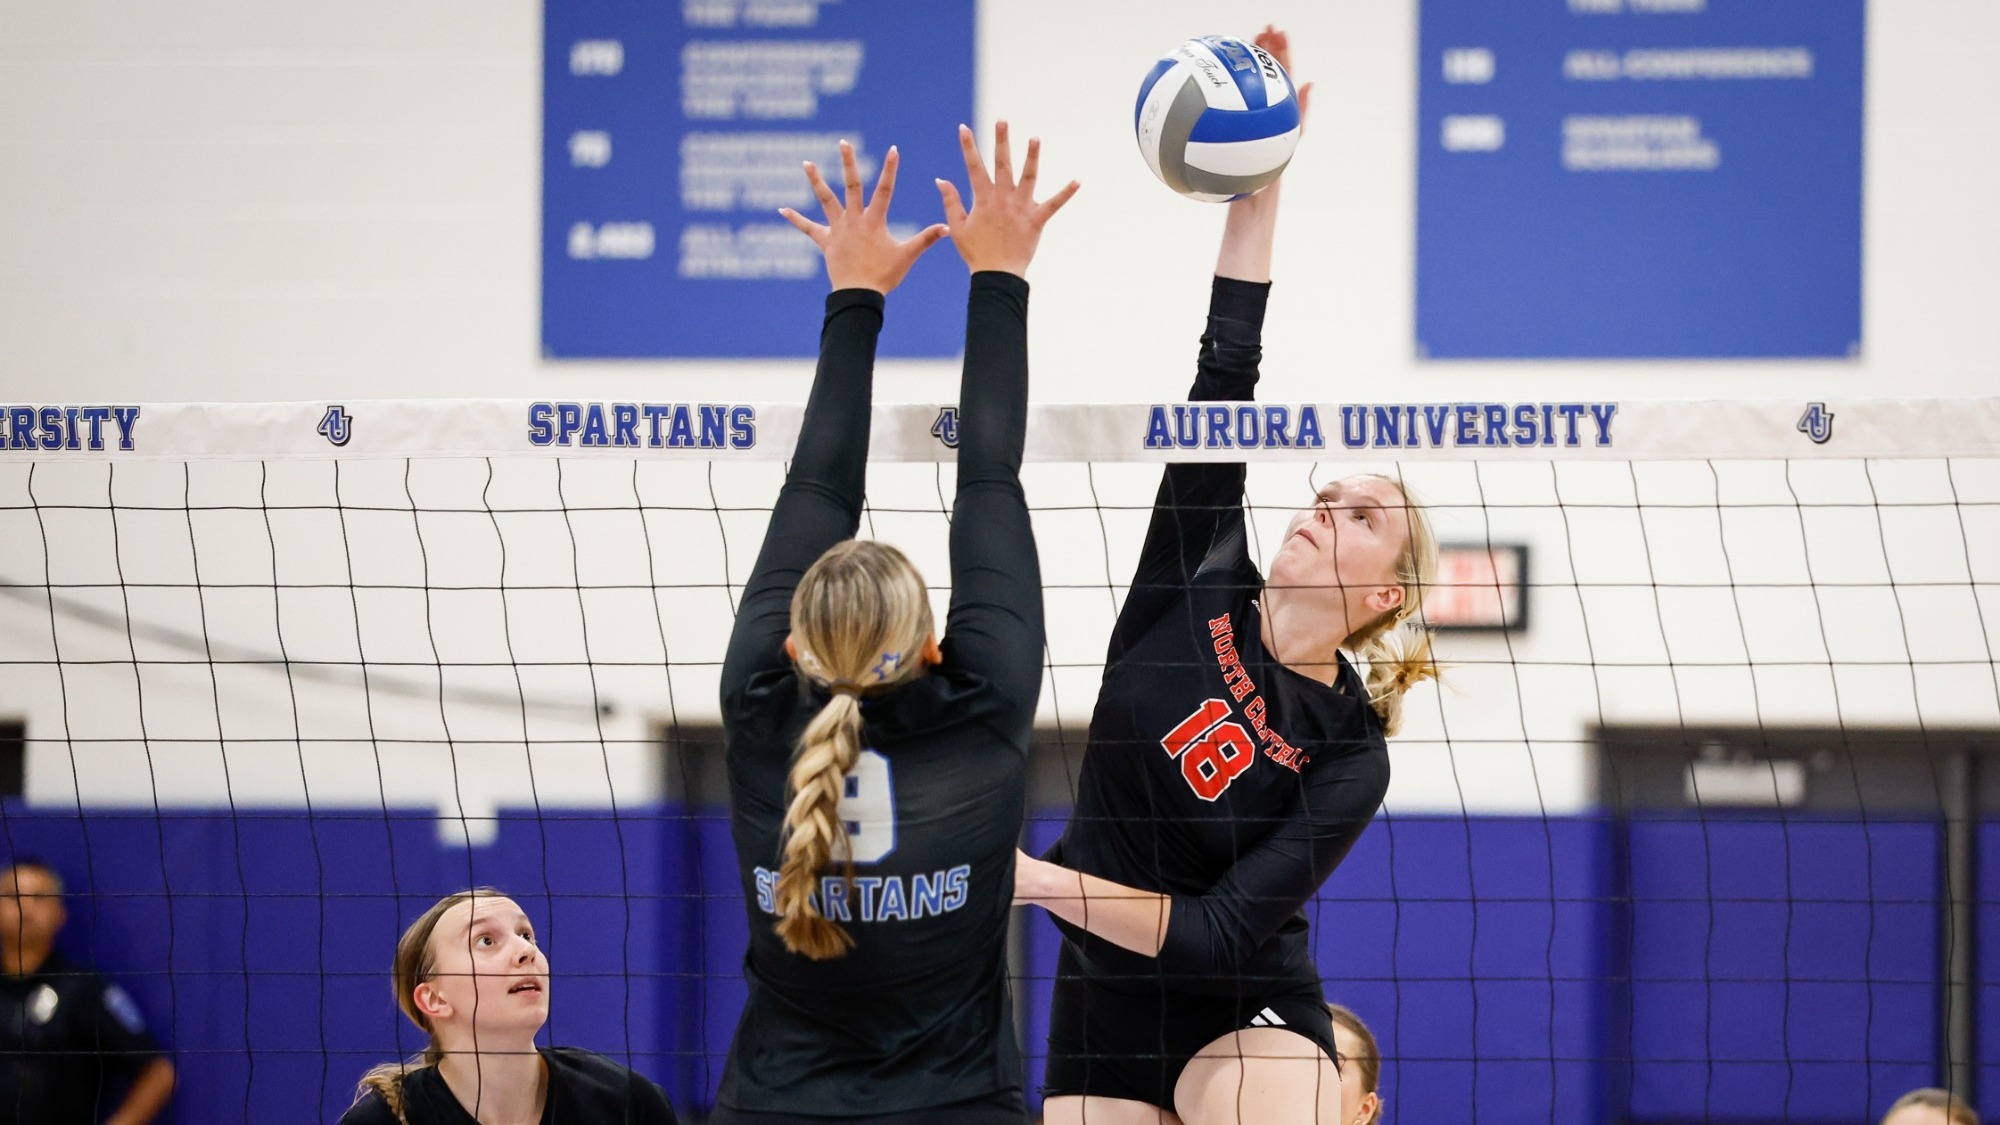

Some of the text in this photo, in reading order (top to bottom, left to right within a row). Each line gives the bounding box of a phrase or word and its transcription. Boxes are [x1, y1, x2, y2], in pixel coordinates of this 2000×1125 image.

[1195, 57, 1228, 89] Touch
[0, 406, 139, 450] RSITY
[528, 402, 757, 450] SPARTANS
[1143, 402, 1619, 450] AURORA UNIVERSITY
[1208, 612, 1256, 703] NORTH
[1160, 698, 1256, 802] 18
[754, 864, 971, 922] SRTANS
